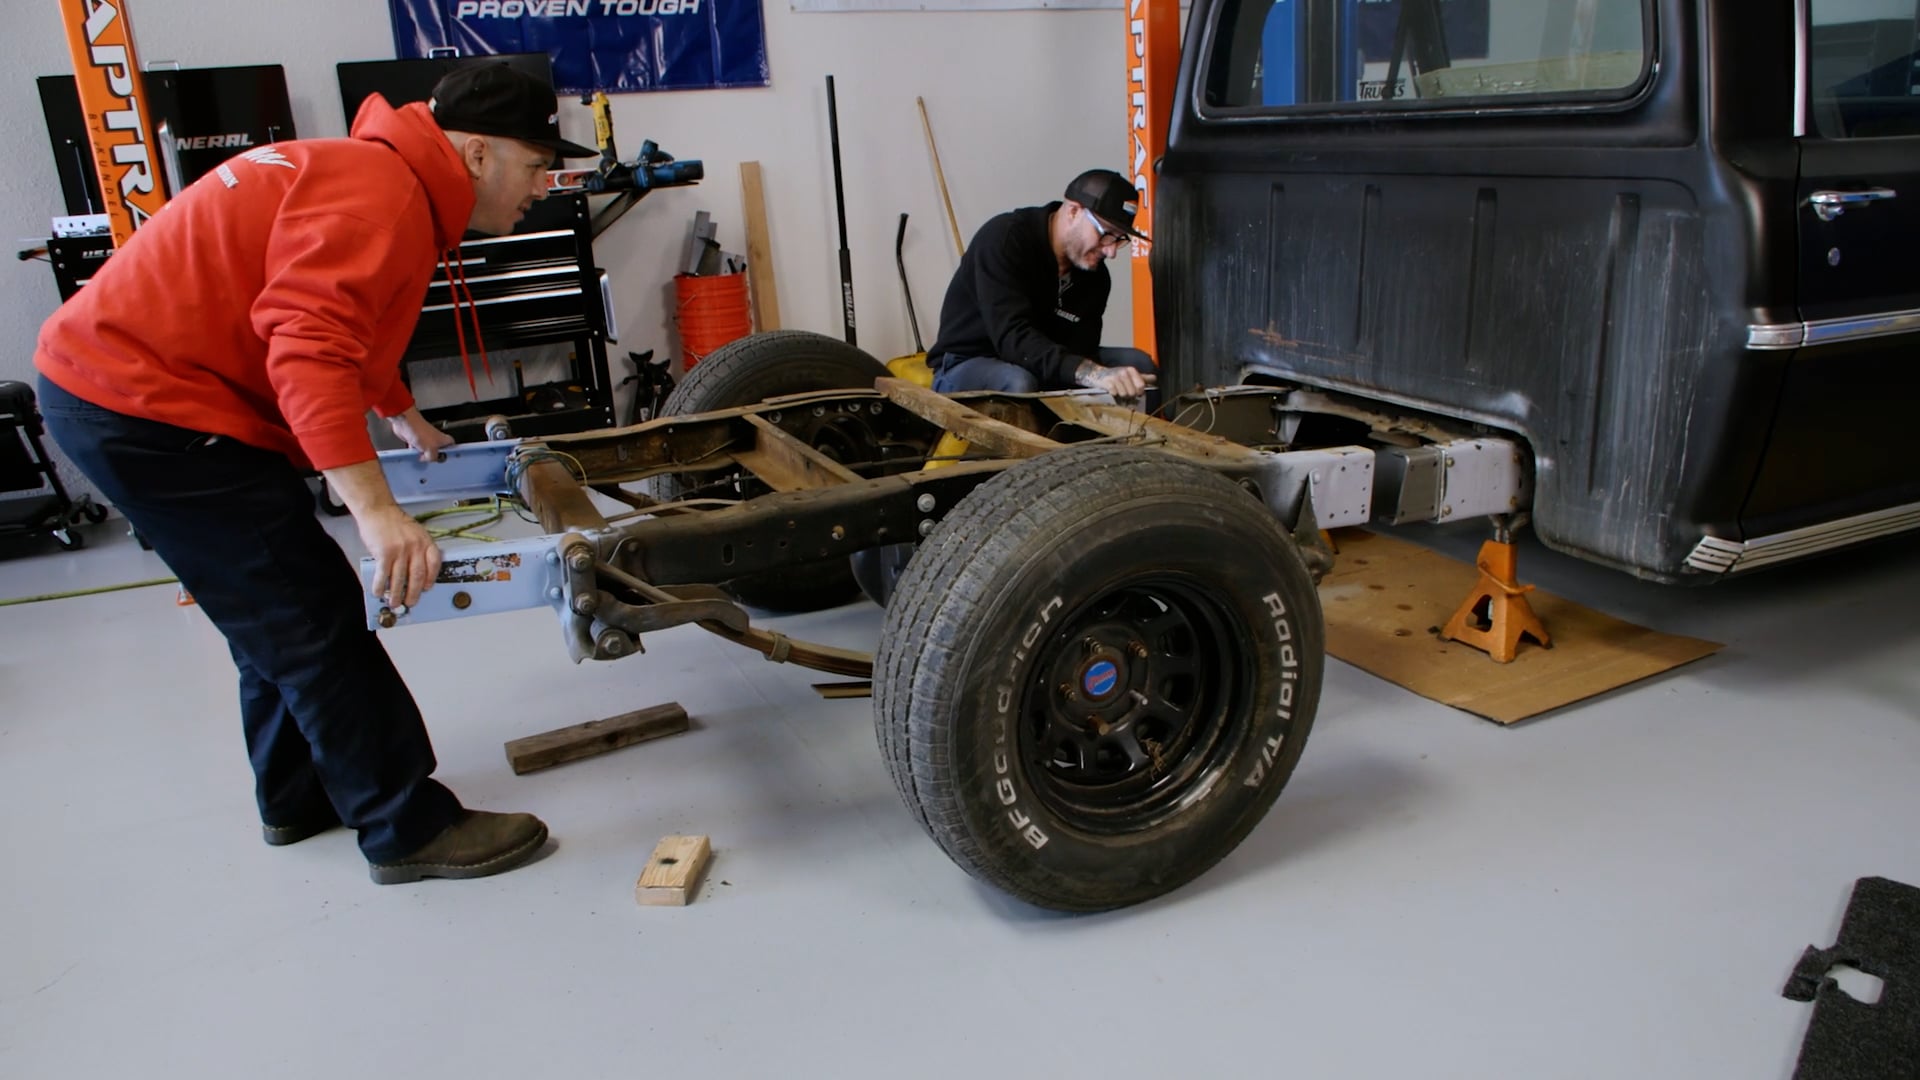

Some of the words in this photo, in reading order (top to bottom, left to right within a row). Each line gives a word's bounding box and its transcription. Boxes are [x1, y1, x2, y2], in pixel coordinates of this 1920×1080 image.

[456, 0, 589, 19] PROVEN
[602, 0, 700, 16] TOUGH
[1262, 592, 1298, 720] Radial
[1243, 733, 1284, 787] T/A
